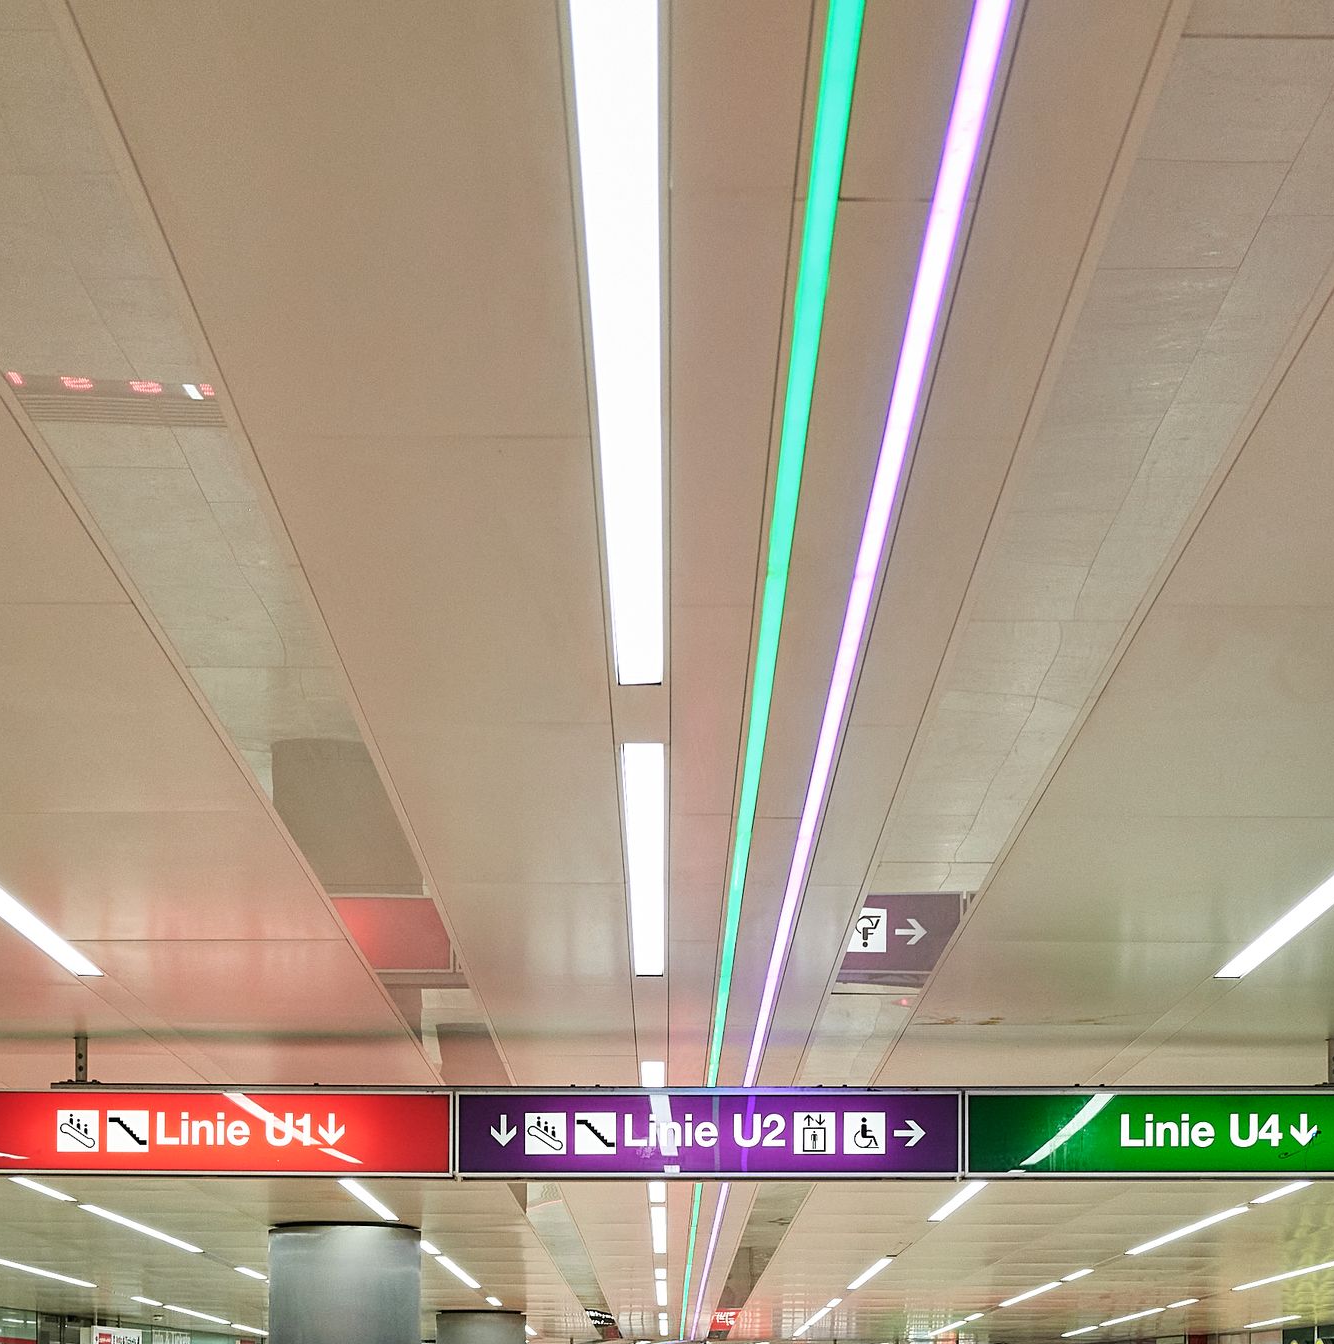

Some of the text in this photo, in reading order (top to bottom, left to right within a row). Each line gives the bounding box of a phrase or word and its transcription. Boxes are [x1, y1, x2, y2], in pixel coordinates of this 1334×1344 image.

[156, 1111, 312, 1147] Linie U1
[624, 1112, 786, 1148] Linie U2
[1120, 1113, 1283, 1148] Linie U4
